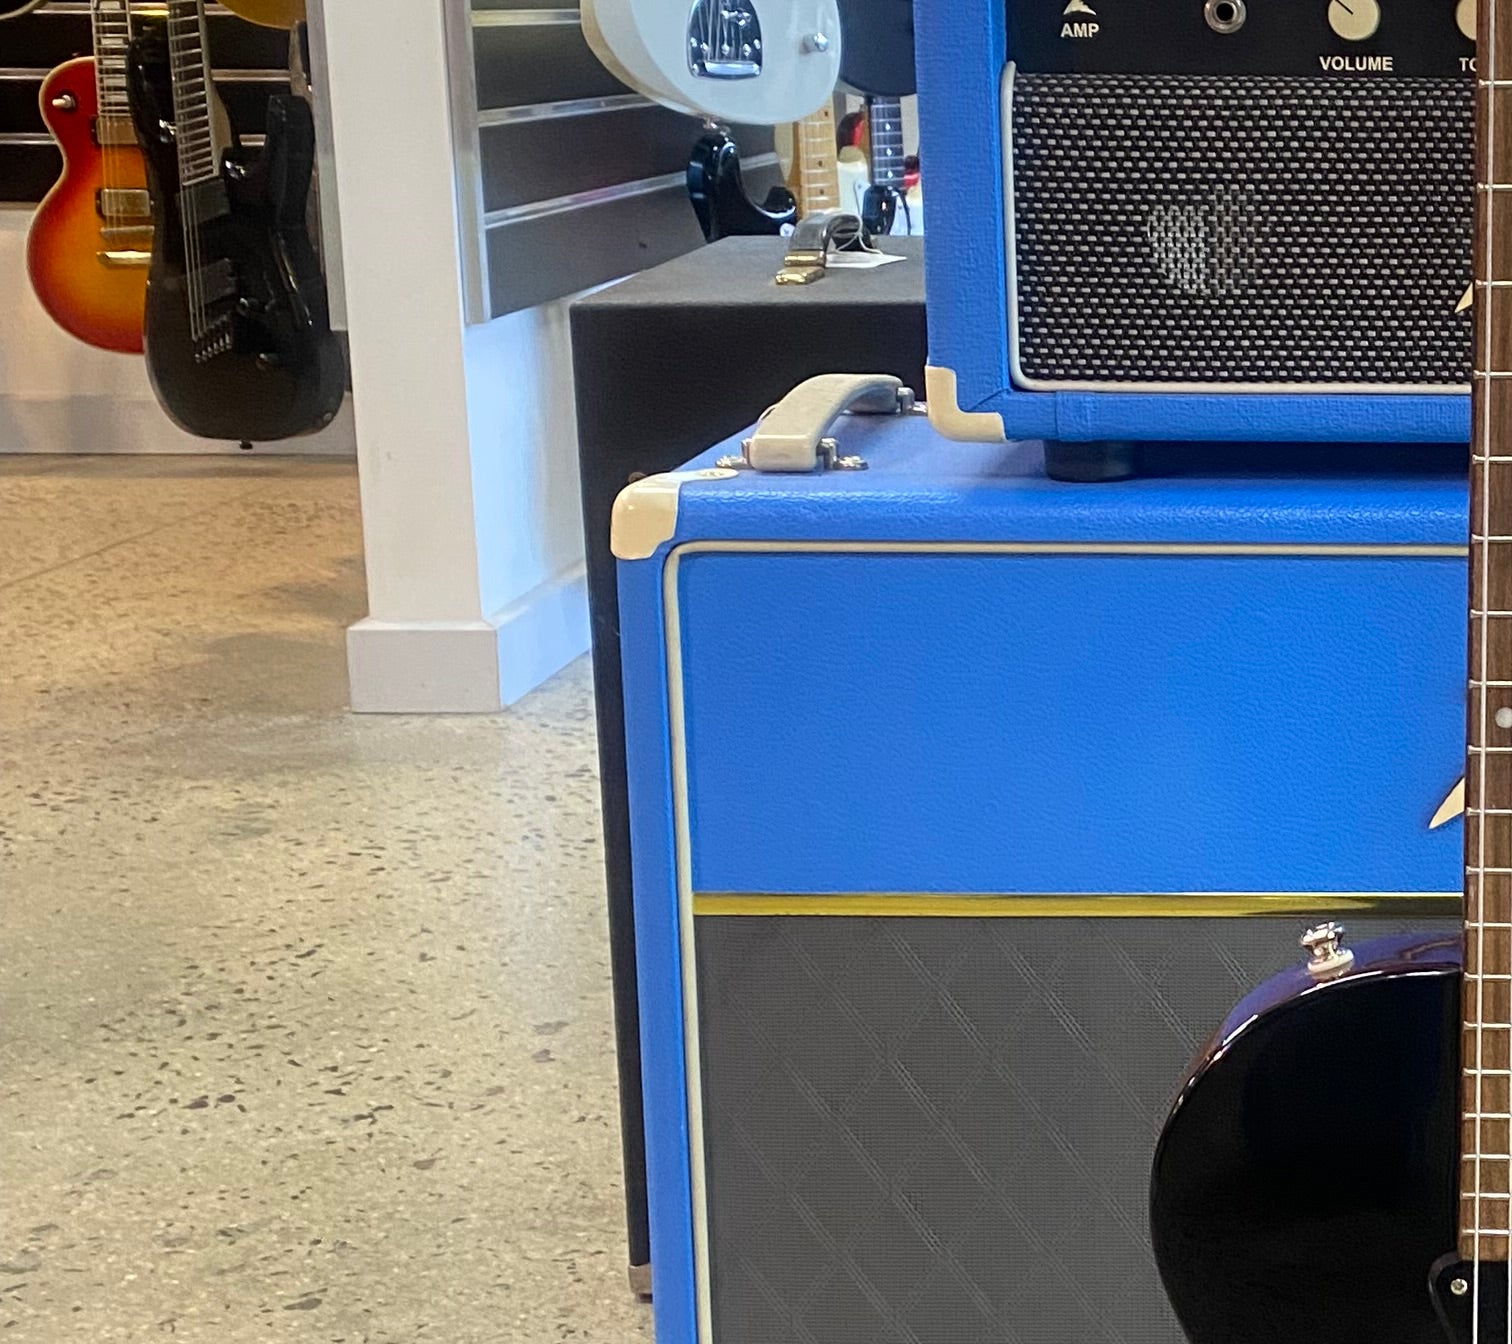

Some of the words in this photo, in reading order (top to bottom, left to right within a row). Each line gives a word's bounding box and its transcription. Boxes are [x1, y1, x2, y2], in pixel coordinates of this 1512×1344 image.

[1060, 22, 1100, 38] AMP
[1319, 55, 1394, 72] VOLUME
[1458, 57, 1478, 73] TO
